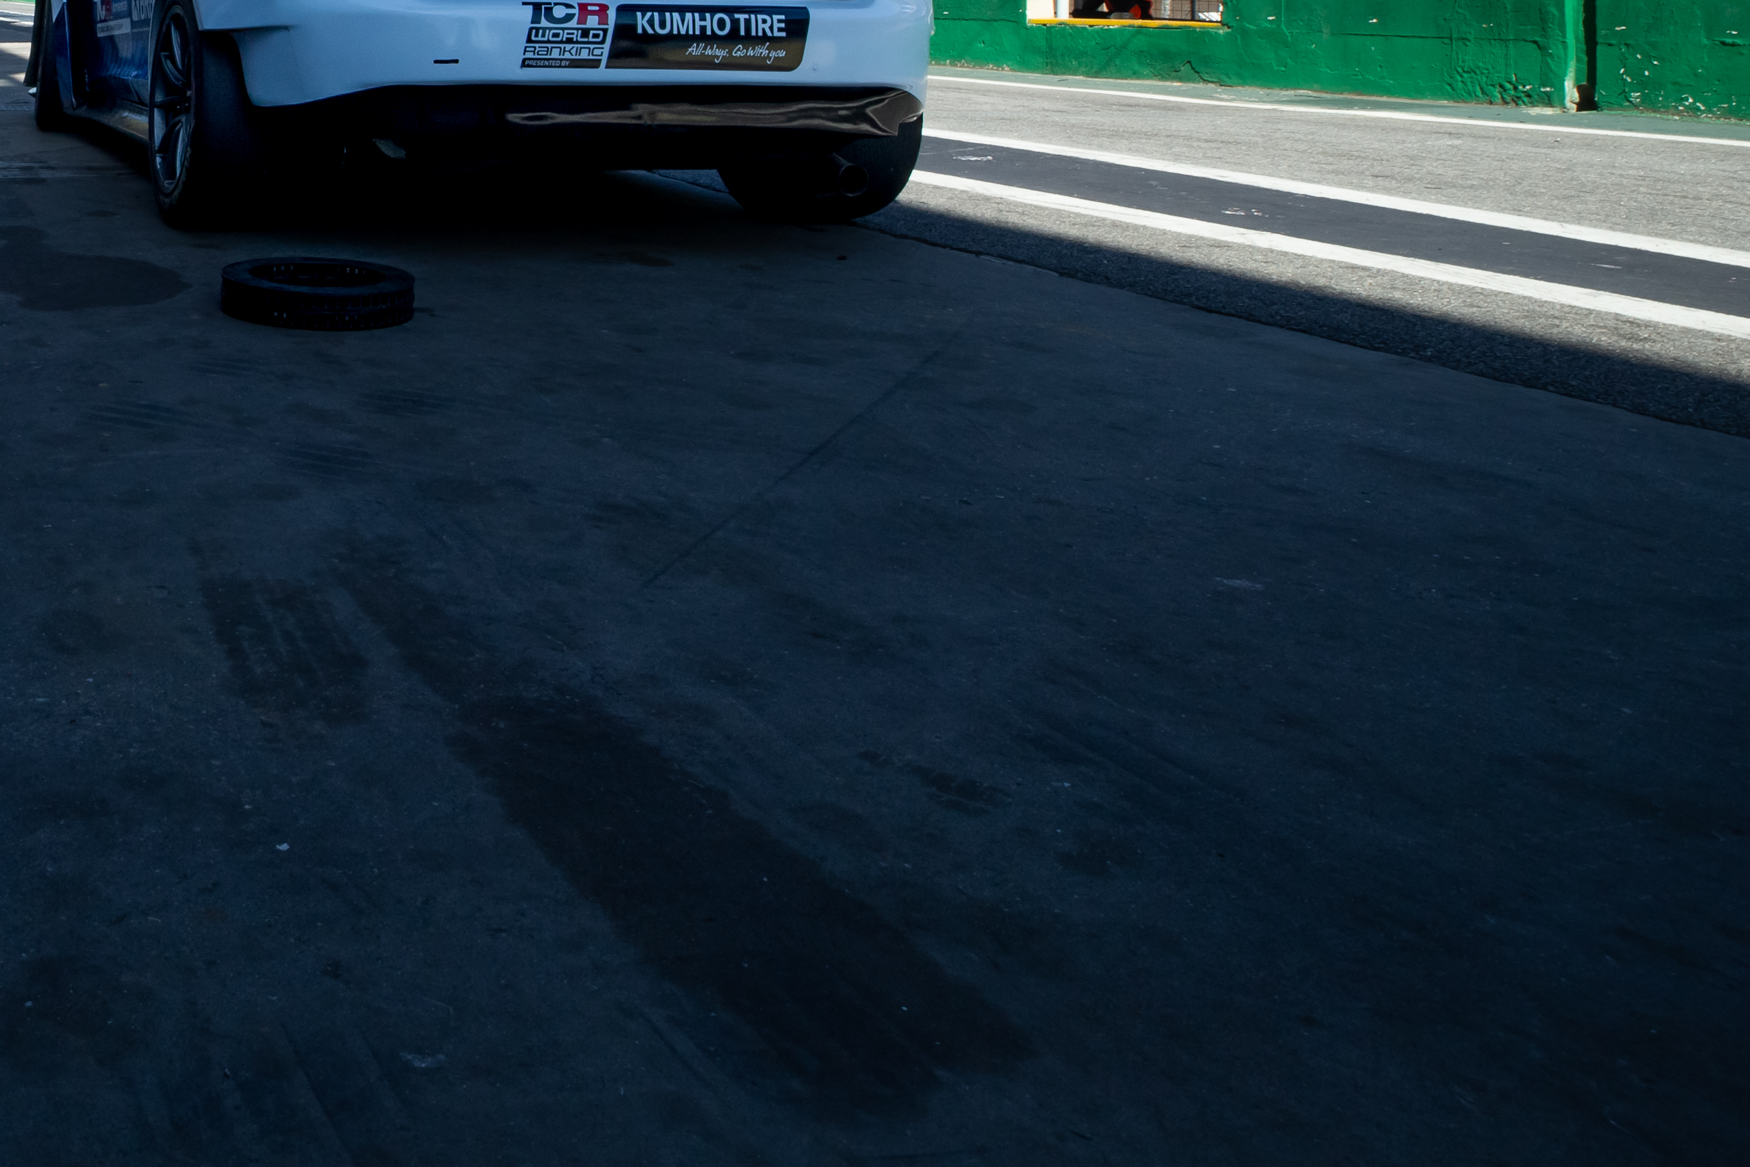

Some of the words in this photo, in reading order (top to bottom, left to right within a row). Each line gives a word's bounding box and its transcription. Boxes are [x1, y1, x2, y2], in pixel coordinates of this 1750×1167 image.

[521, 1, 610, 25] TCR
[636, 11, 731, 35] KUMHO
[734, 13, 787, 37] TIRE
[531, 28, 605, 42] WORLD
[524, 59, 559, 67] PRESENTED
[560, 59, 570, 67] BY
